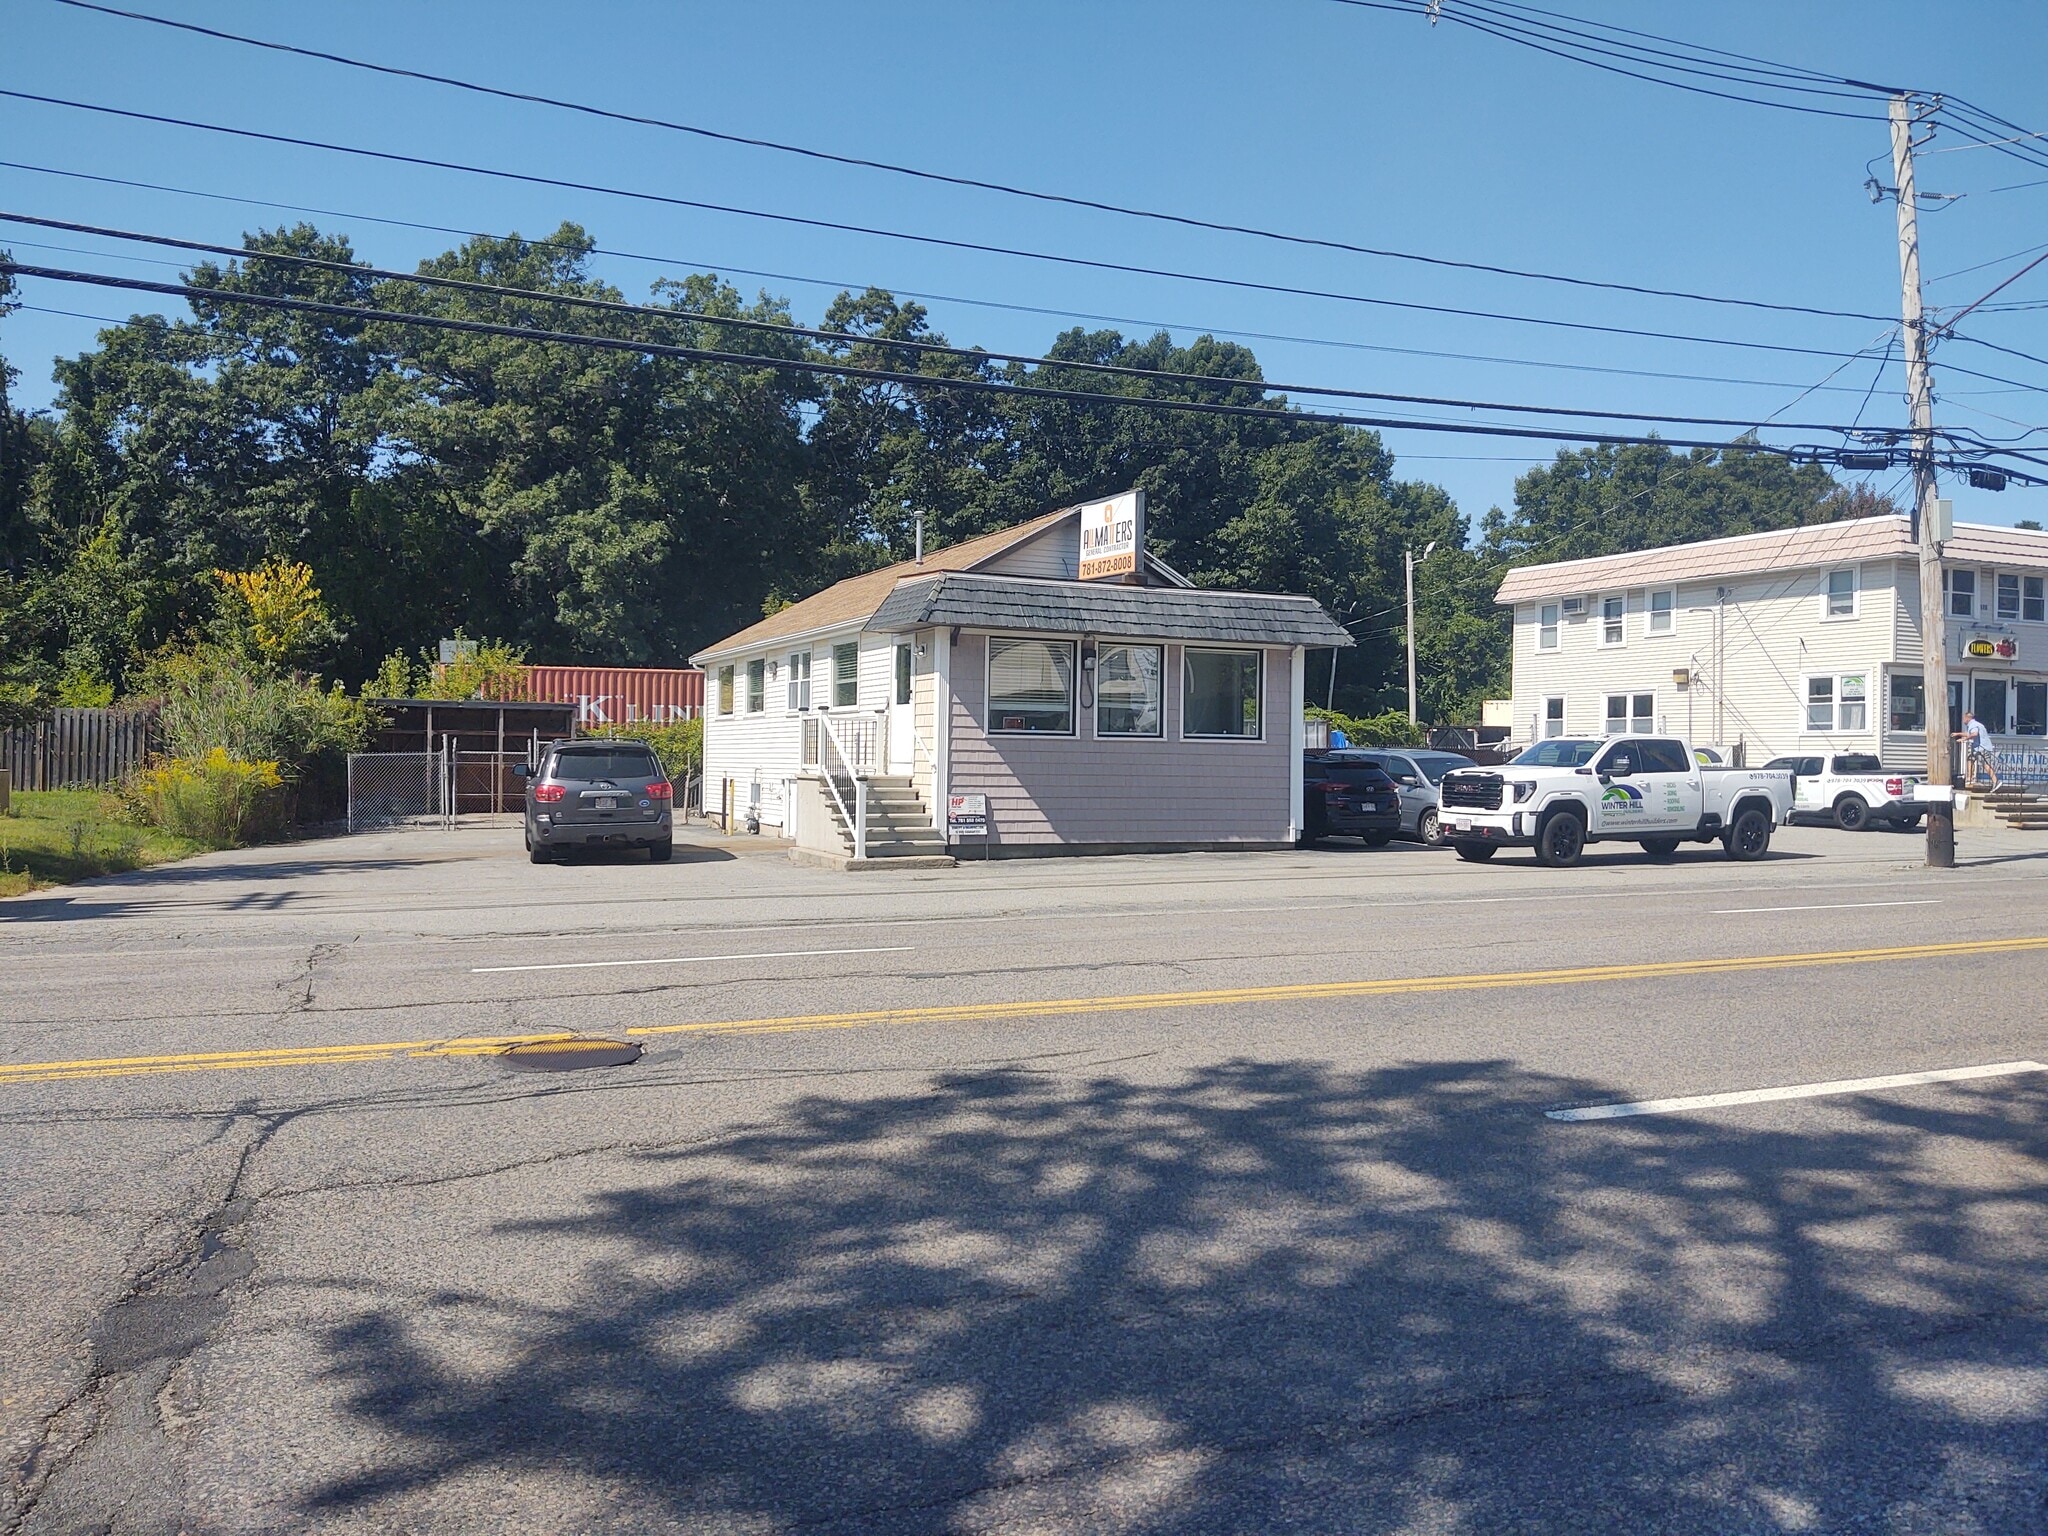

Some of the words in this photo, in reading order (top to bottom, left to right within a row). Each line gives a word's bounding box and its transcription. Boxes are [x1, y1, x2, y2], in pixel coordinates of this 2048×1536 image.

[1086, 547, 1102, 556] GENERAL
[1103, 542, 1129, 552] CONTRACTOR
[1082, 556, 1132, 576] 781-872-8008
[1971, 643, 1993, 654] FLOWERS
[1601, 801, 1628, 810] WINTER
[1629, 800, 1643, 809] HILL
